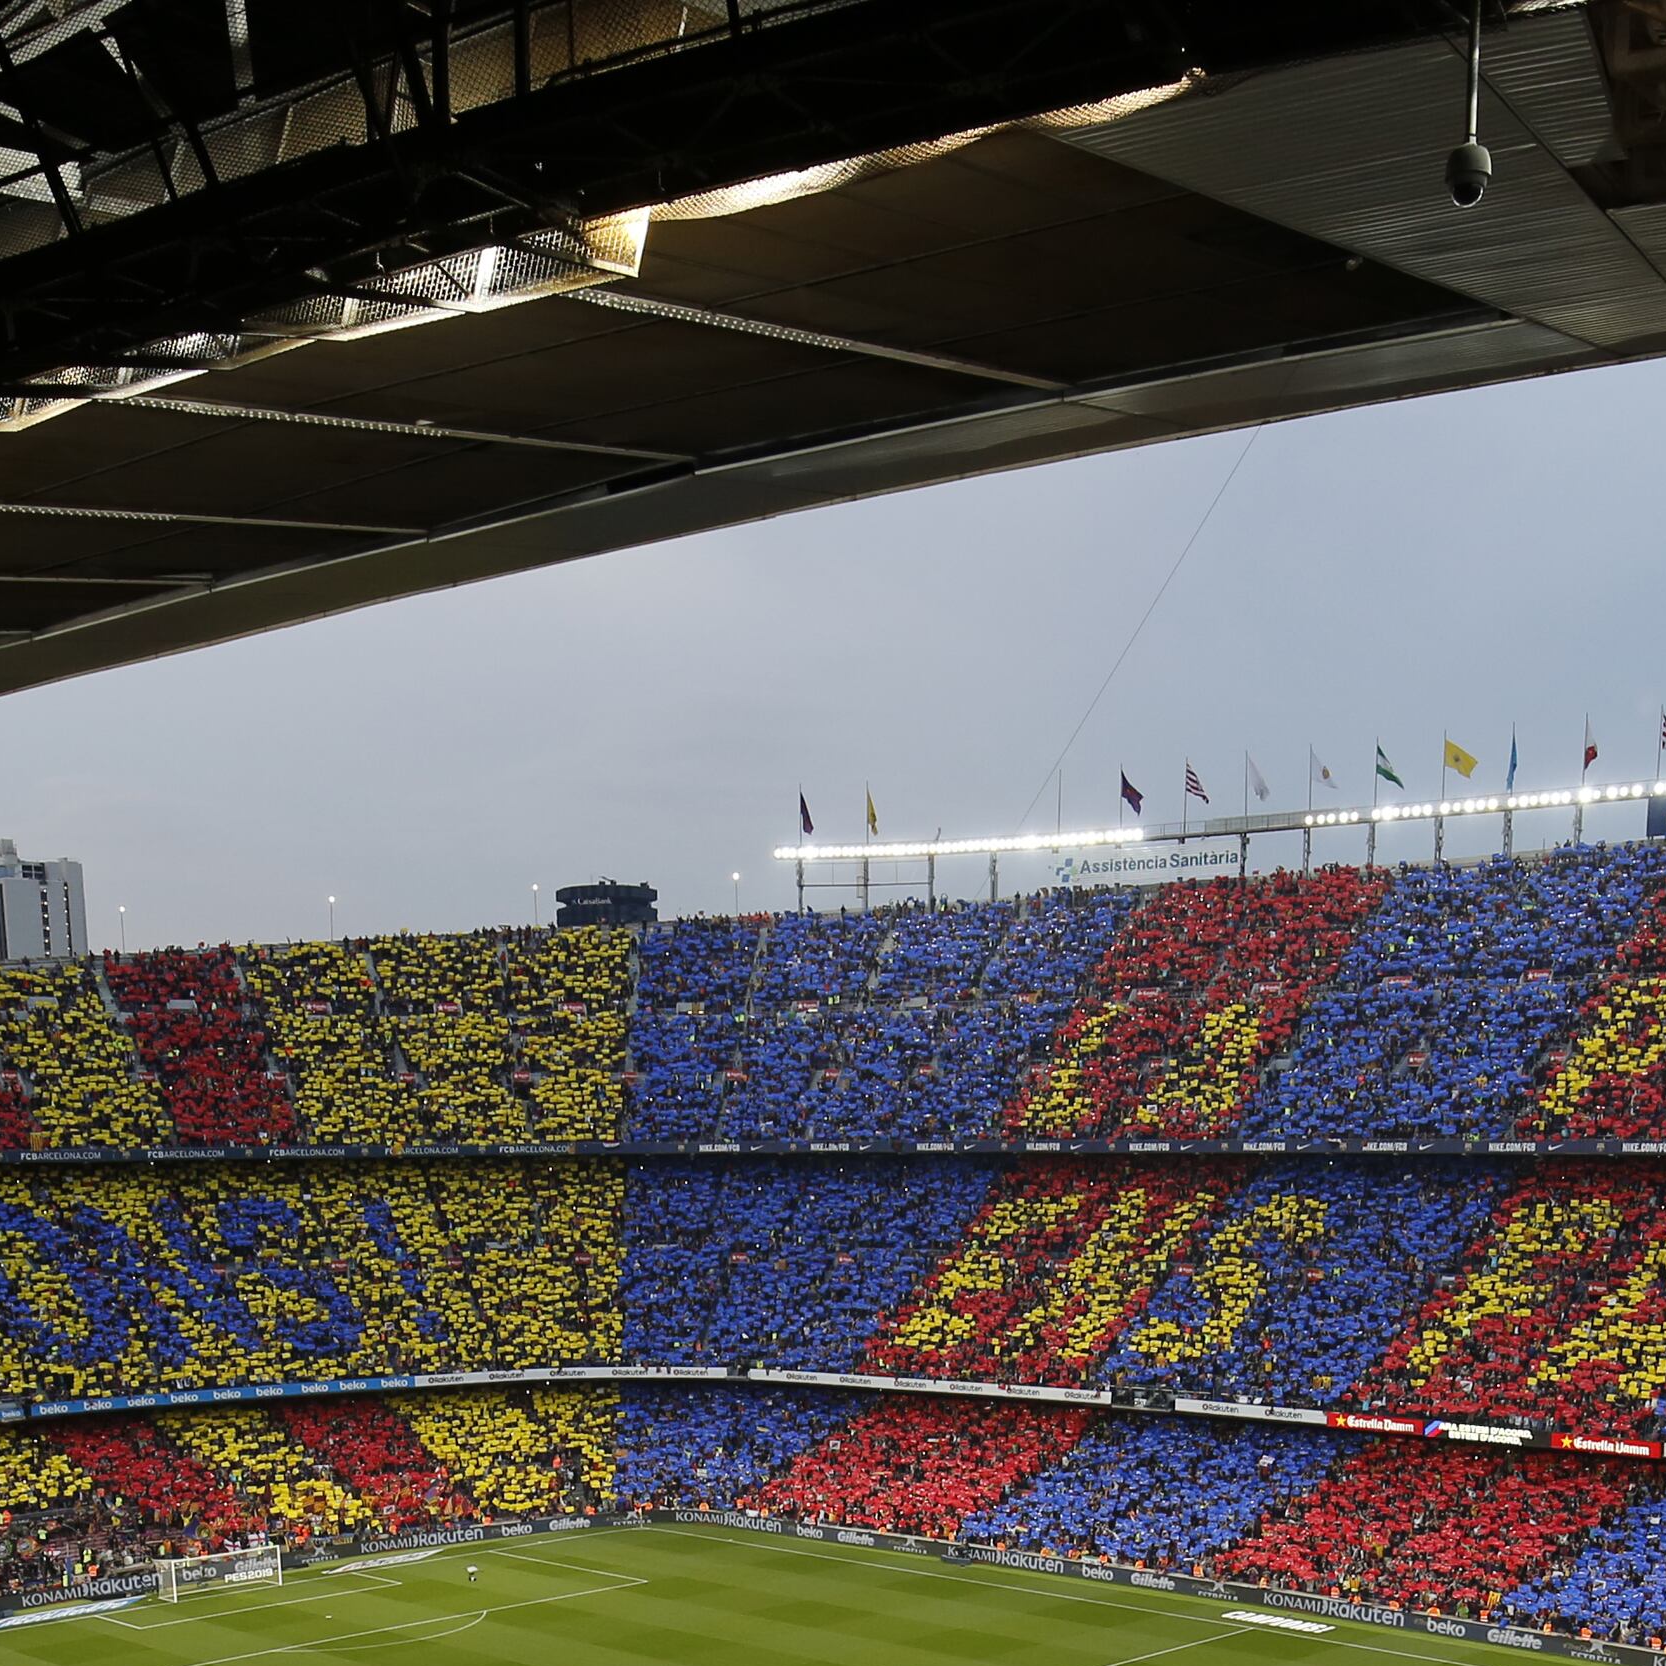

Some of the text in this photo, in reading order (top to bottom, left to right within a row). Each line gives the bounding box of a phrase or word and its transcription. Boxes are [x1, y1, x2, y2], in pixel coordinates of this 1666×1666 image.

[1080, 851, 1238, 875] Assistència Sanitària
[147, 1148, 225, 1161] FCBARCELONA.COM
[269, 1147, 345, 1160] FCBARCELONA.COM
[1488, 1142, 1536, 1153] NIKE.COM/FCB
[21, 1150, 101, 1163] FCBARCELONA.COM
[255, 1385, 284, 1399] beko
[301, 1382, 329, 1396] beko
[339, 1380, 367, 1394] beko
[380, 1376, 409, 1391] beko
[126, 1394, 156, 1409] beko
[170, 1391, 199, 1405] beko
[212, 1388, 241, 1402] beko
[38, 1402, 69, 1417] beko
[1208, 1401, 1240, 1415] Rakuten
[1346, 1414, 1416, 1433] Estrella Damm
[1572, 1434, 1614, 1453] Estrella
[548, 1517, 592, 1535] Gillette
[675, 1511, 727, 1528] KONAMI
[728, 1513, 782, 1534] Rakuten
[501, 1523, 533, 1539] beko
[795, 1523, 824, 1542] beko
[836, 1531, 875, 1548] Gillette
[360, 1540, 414, 1556] KONAMI
[418, 1528, 484, 1554] Rakuten
[1001, 1550, 1065, 1576] Rakuten
[224, 1565, 274, 1585] PES2019
[1081, 1562, 1115, 1582] beko
[87, 1569, 162, 1598] Rakuten
[1130, 1572, 1176, 1592] Gillette
[21, 1588, 82, 1608] KONAMI
[1263, 1593, 1322, 1614] KONAMI
[1328, 1598, 1405, 1628] Rakuten
[1426, 1617, 1467, 1638] beko
[1486, 1629, 1543, 1651] Gillette
